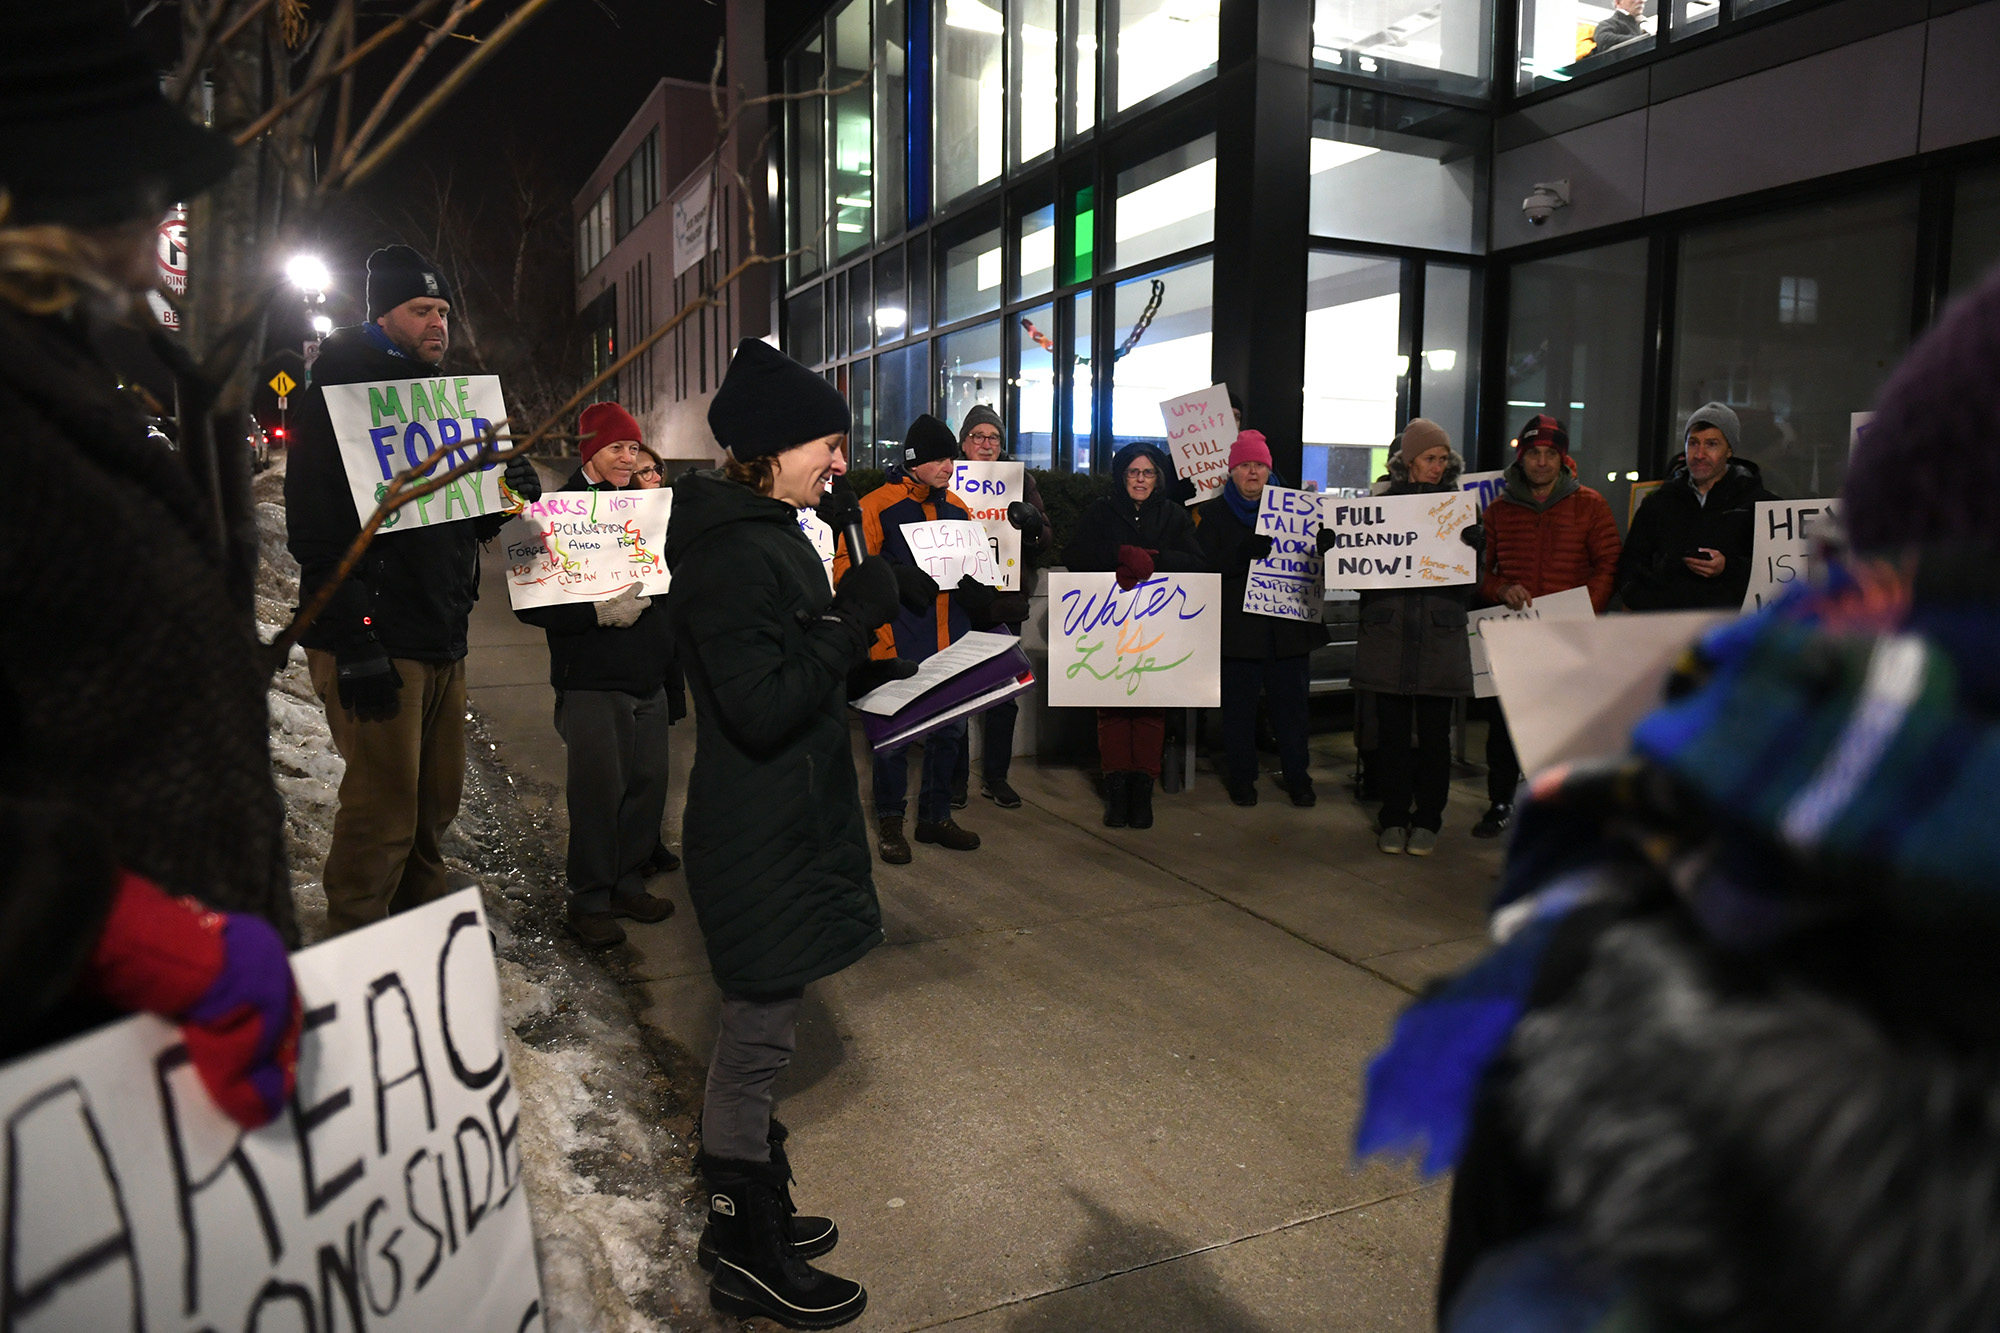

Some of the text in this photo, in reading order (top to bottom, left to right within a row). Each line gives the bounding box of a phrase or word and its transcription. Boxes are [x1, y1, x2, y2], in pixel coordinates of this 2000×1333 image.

[368, 377, 477, 427] MAKE
[1171, 401, 1208, 417] Why
[1169, 413, 1225, 440] wait?
[368, 417, 500, 480] FORD
[1181, 439, 1224, 460] FULL
[956, 465, 1006, 496] FORD
[412, 470, 485, 525] PAY
[517, 496, 643, 520] ARKS NOT
[968, 507, 1008, 522] ROFIT
[1260, 513, 1317, 538] TALK
[1335, 506, 1386, 527] FULL
[553, 522, 626, 539] POLLUTION
[911, 524, 981, 550] CLEAN
[1335, 531, 1419, 549] CLEANUP
[507, 541, 550, 560] FORGE
[568, 538, 601, 550] AHEAD
[924, 555, 953, 578] IT
[961, 550, 995, 580] UP!
[1338, 555, 1413, 579] NOW!
[557, 571, 597, 586] CLEAN
[611, 569, 622, 581] IT
[1250, 577, 1312, 595] SUPPORT
[1061, 576, 1207, 637] Water
[1247, 591, 1282, 604] FULL
[1263, 603, 1318, 620] CLEANUP
[1066, 634, 1195, 696] Life
